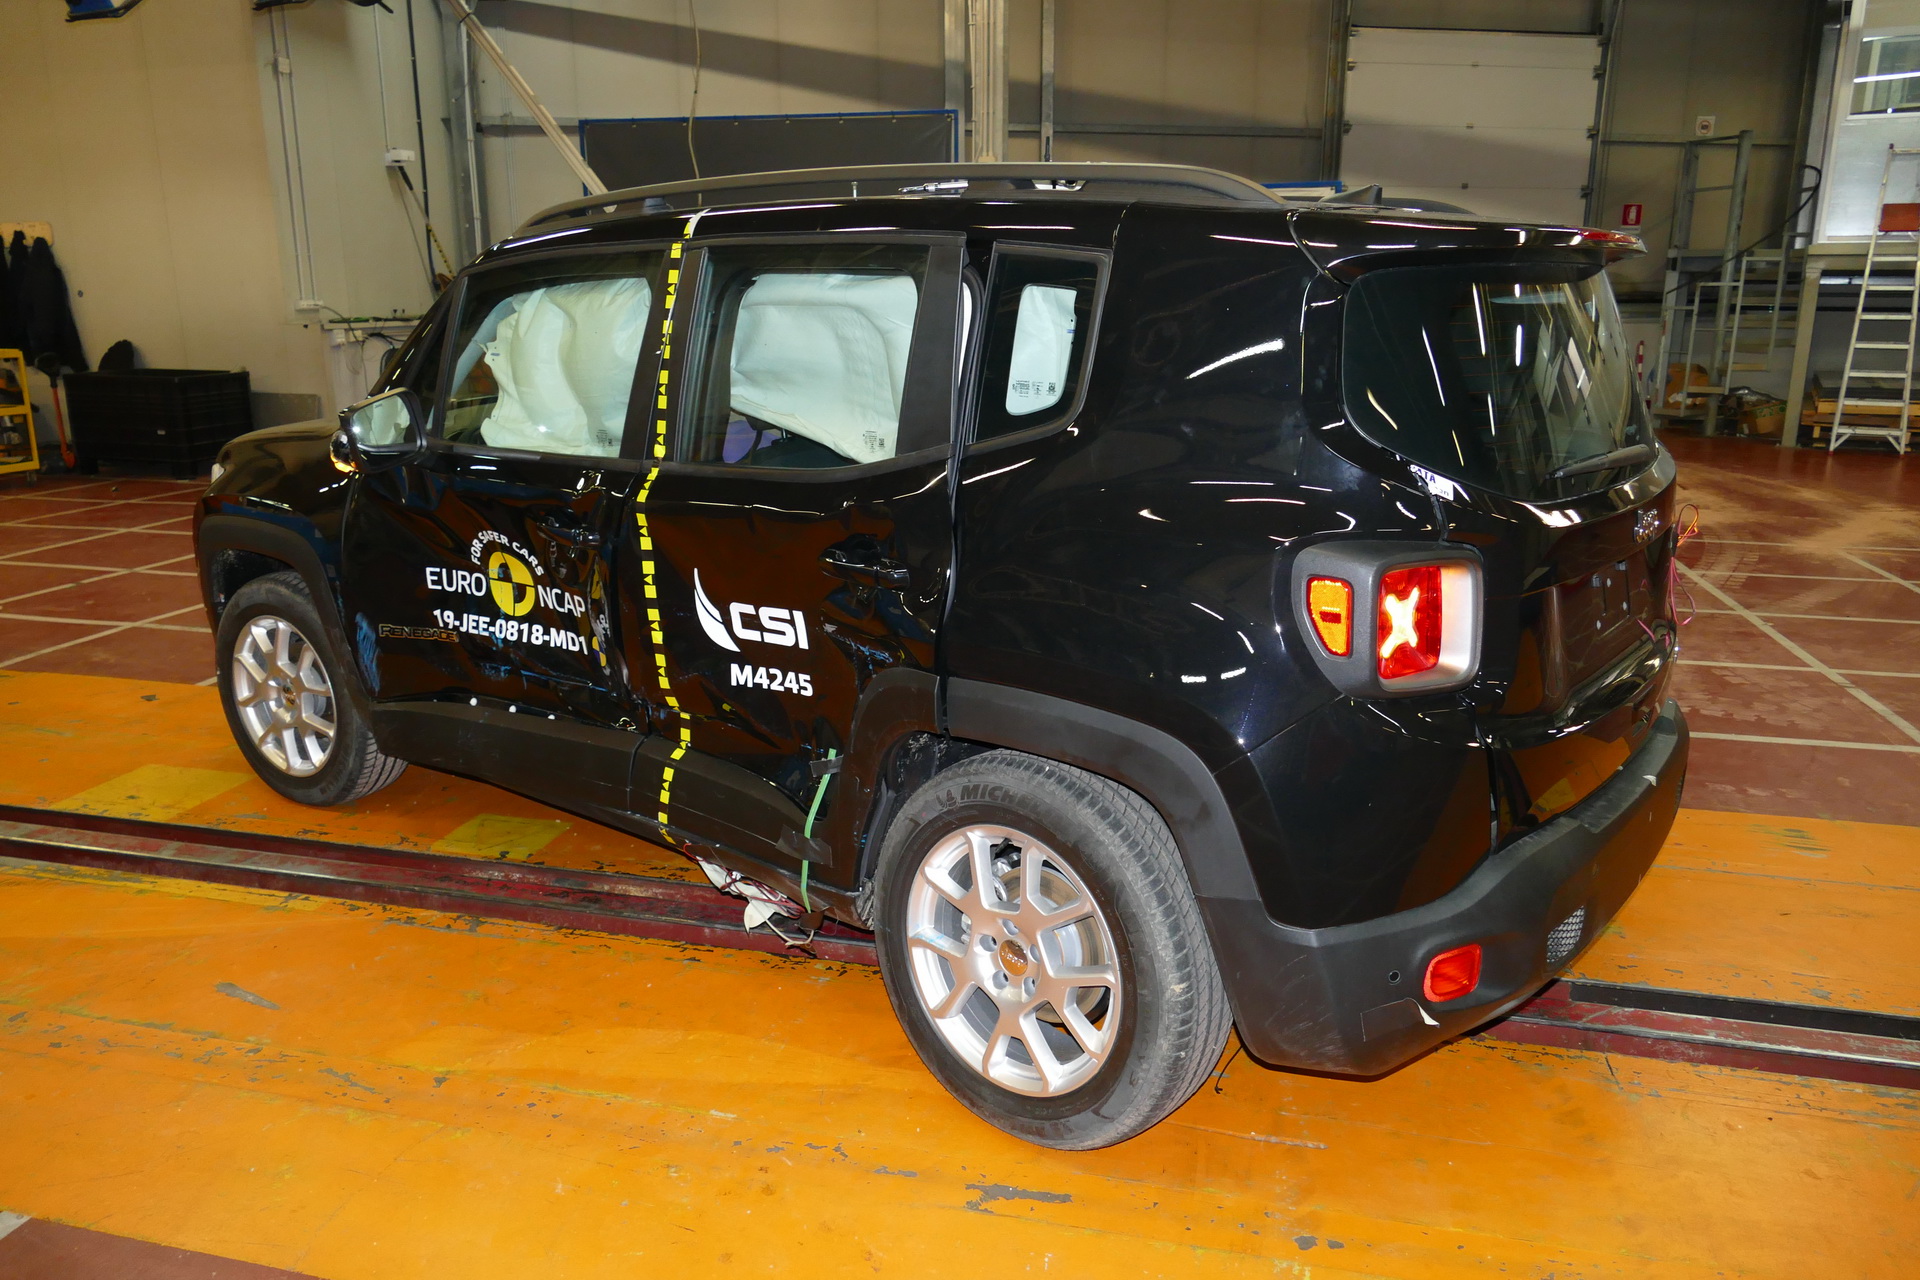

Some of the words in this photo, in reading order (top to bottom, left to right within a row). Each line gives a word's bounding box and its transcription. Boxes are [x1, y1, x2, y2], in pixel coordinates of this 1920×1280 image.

[470, 538, 484, 565] FOR
[478, 530, 510, 546] SAFER
[512, 541, 544, 576] CARS
[425, 566, 487, 597] EURO
[537, 584, 586, 618] NCAP
[378, 623, 460, 643] RENEGADE
[433, 608, 589, 655] 19-JEE-0818-MD1
[729, 602, 809, 650] CSI
[730, 663, 814, 697] M4245
